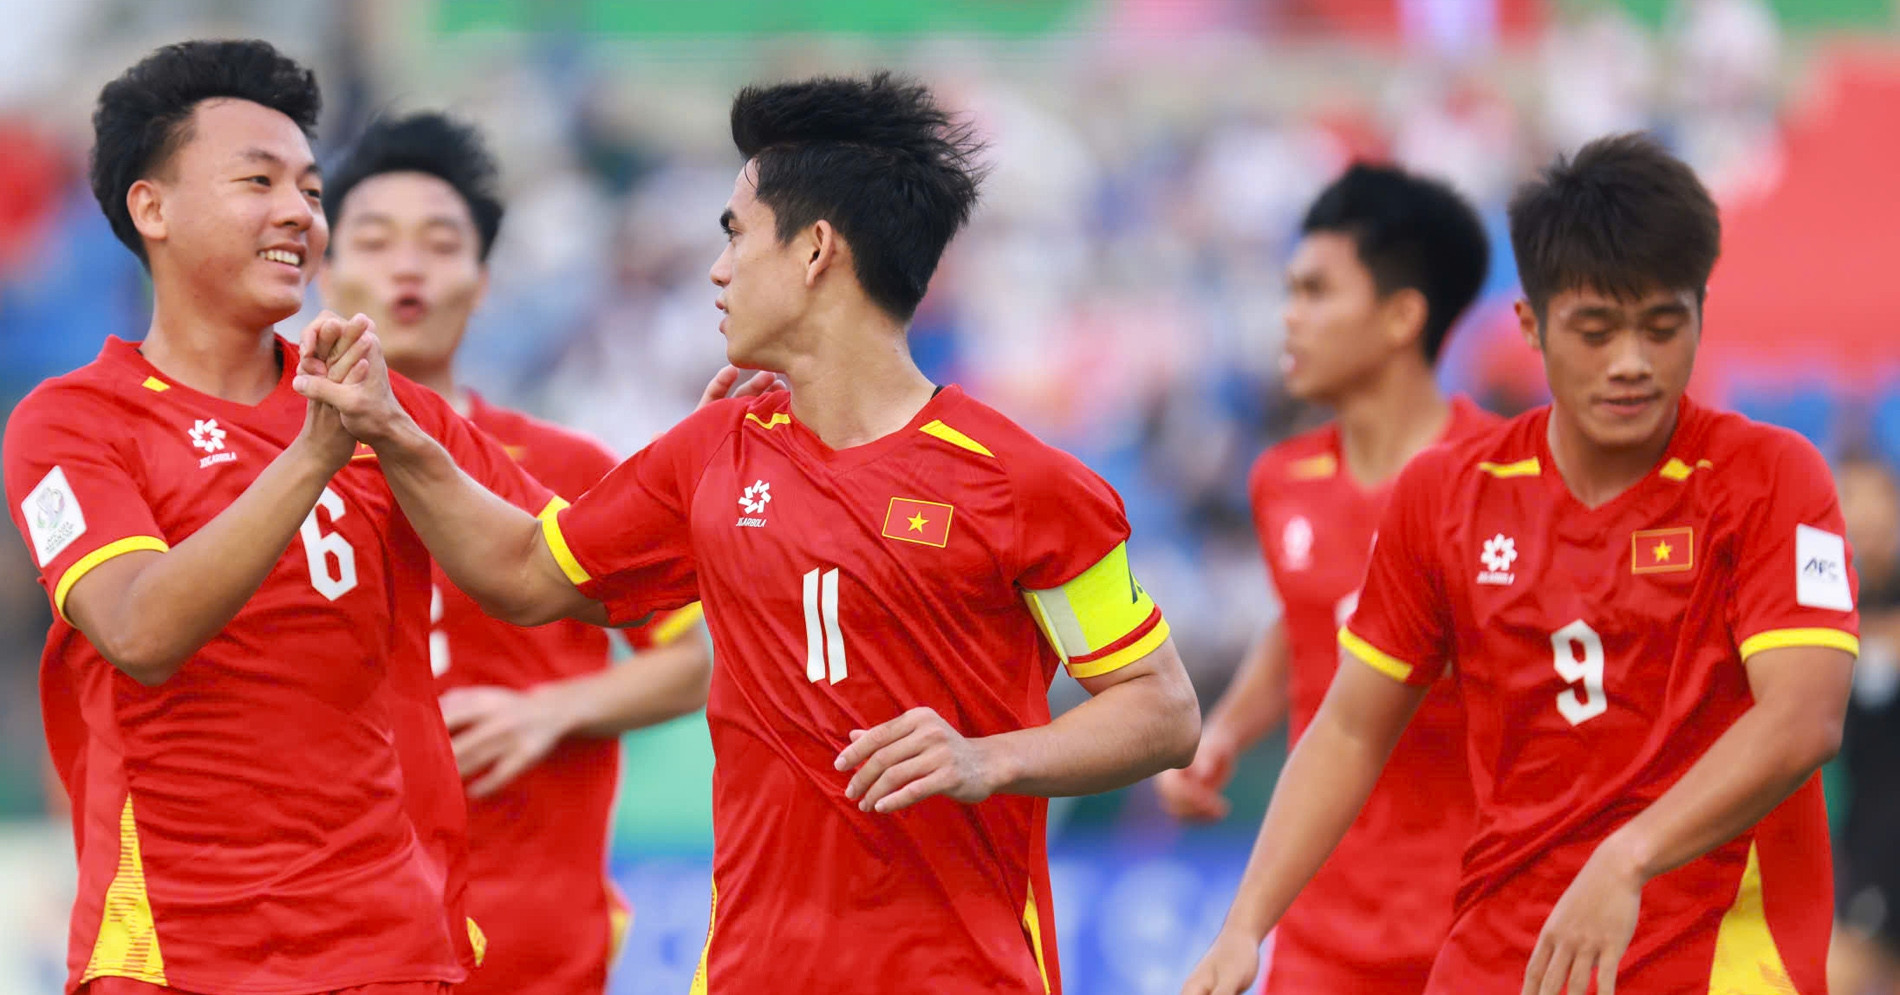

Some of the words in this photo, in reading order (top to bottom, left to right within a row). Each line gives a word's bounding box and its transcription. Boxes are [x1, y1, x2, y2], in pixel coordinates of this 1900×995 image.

[300, 486, 358, 602] 6
[802, 566, 848, 686] 11
[1550, 618, 1608, 727] 9
